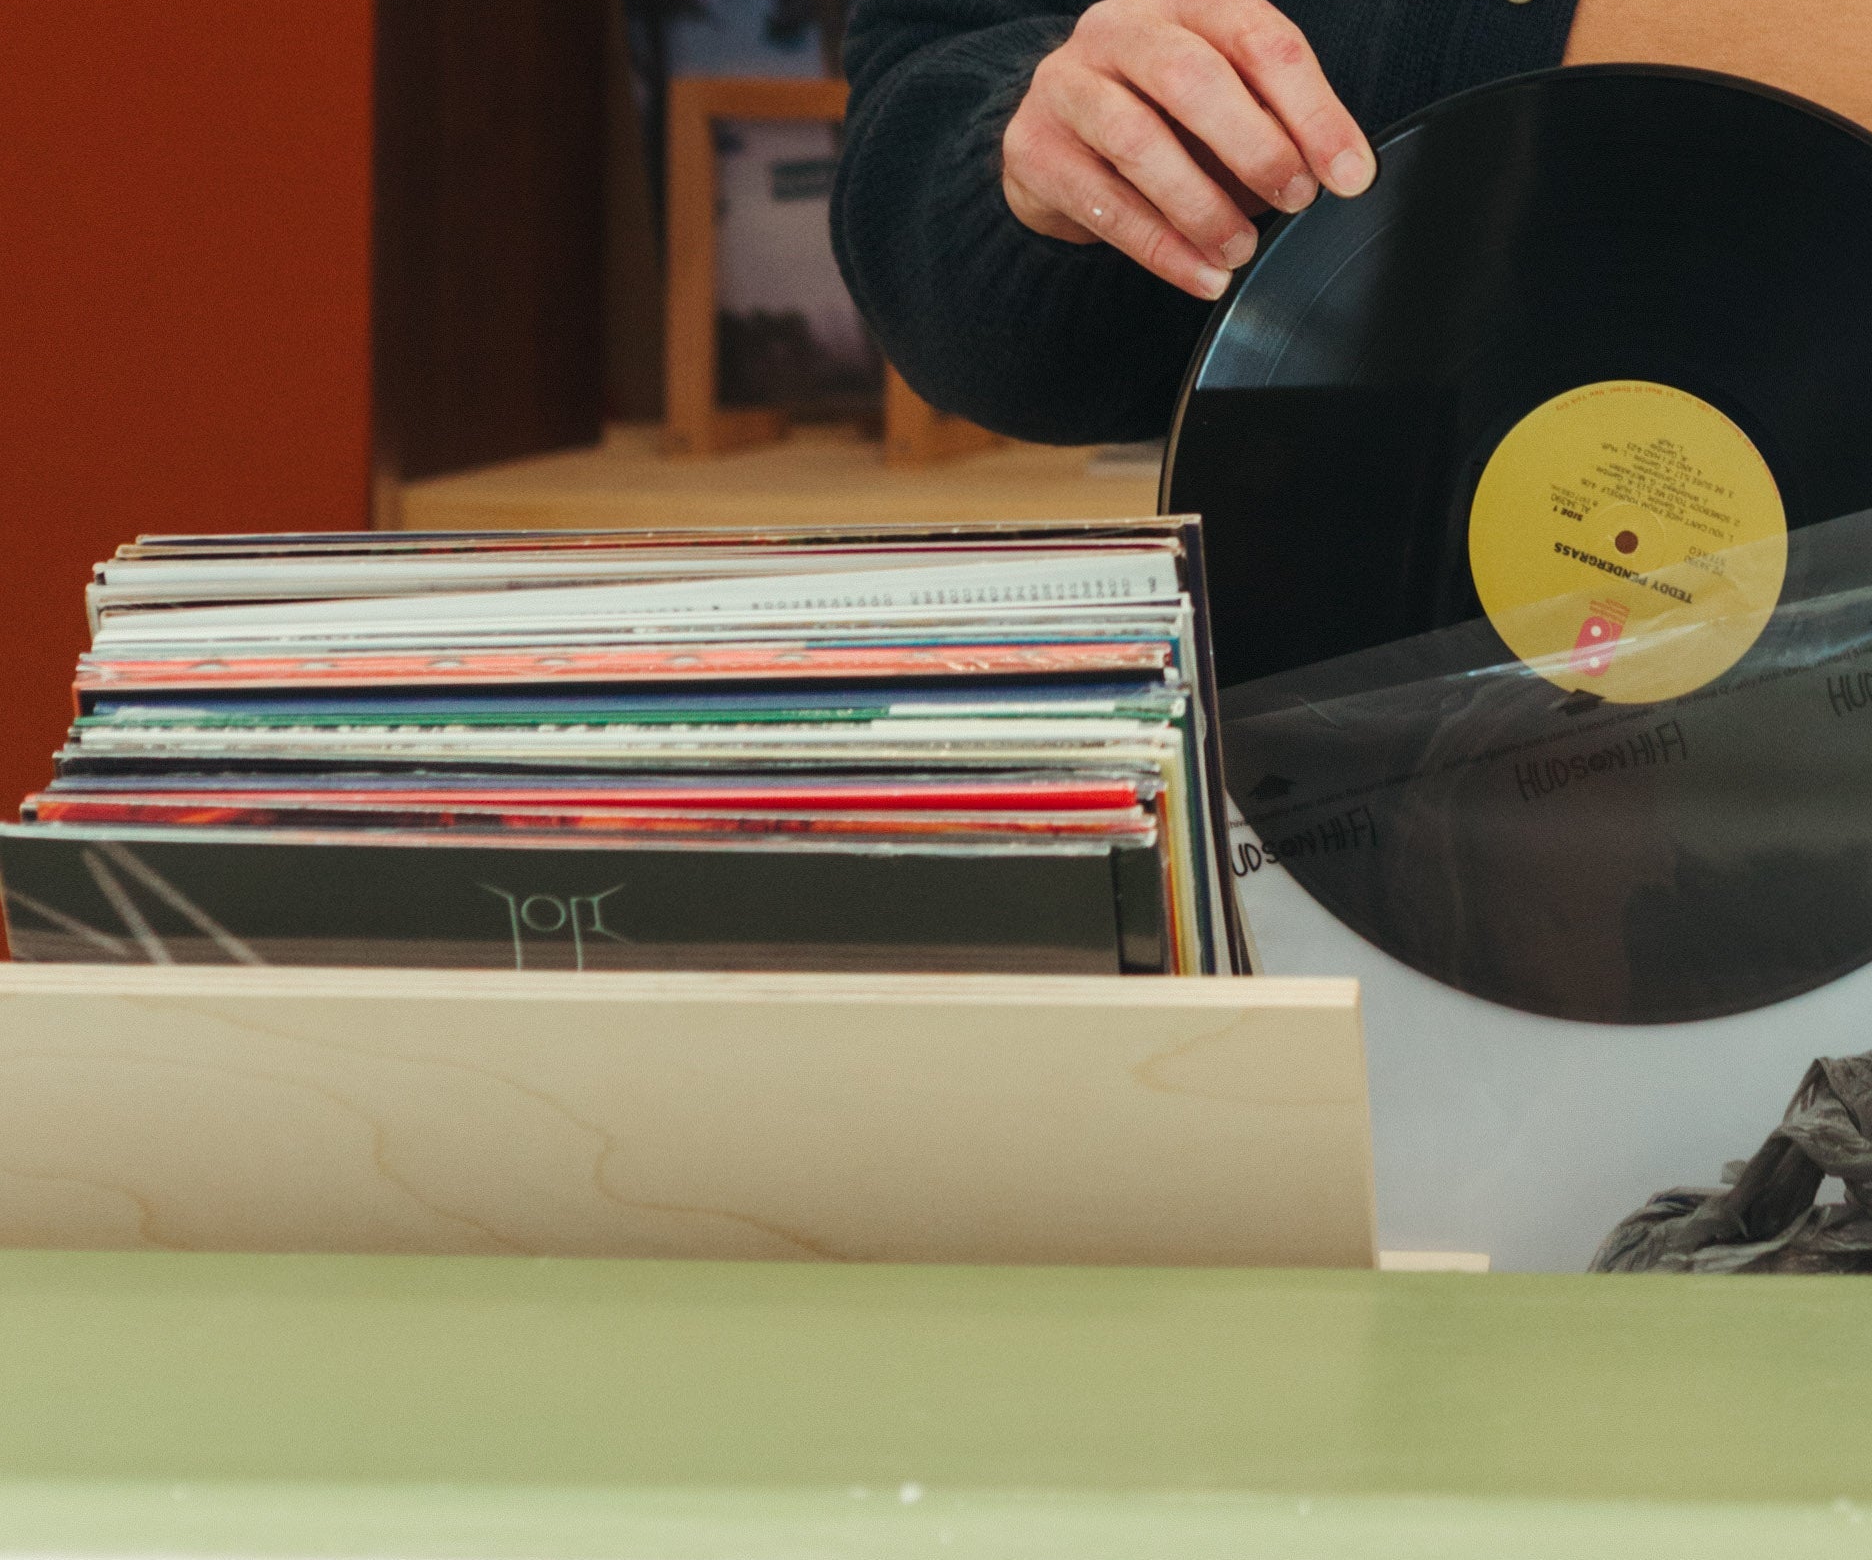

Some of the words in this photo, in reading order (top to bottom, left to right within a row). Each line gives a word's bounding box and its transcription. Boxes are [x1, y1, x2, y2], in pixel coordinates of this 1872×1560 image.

[1548, 491, 1579, 511] 34390
[1551, 504, 1558, 512] 1
[1640, 501, 1664, 516] FROM
[1559, 506, 1583, 522] SIDE
[1579, 504, 1591, 515] AL
[1664, 510, 1684, 523] HIDE
[1683, 517, 1708, 533] CAN'T
[1707, 526, 1725, 539] YOU
[1553, 541, 1649, 587] PENDERGRASS
[1687, 545, 1727, 567] STEREO
[1650, 579, 1694, 605] TEDDY
[1514, 743, 1626, 802] HUDSON
[1231, 829, 1317, 877] UDSON
